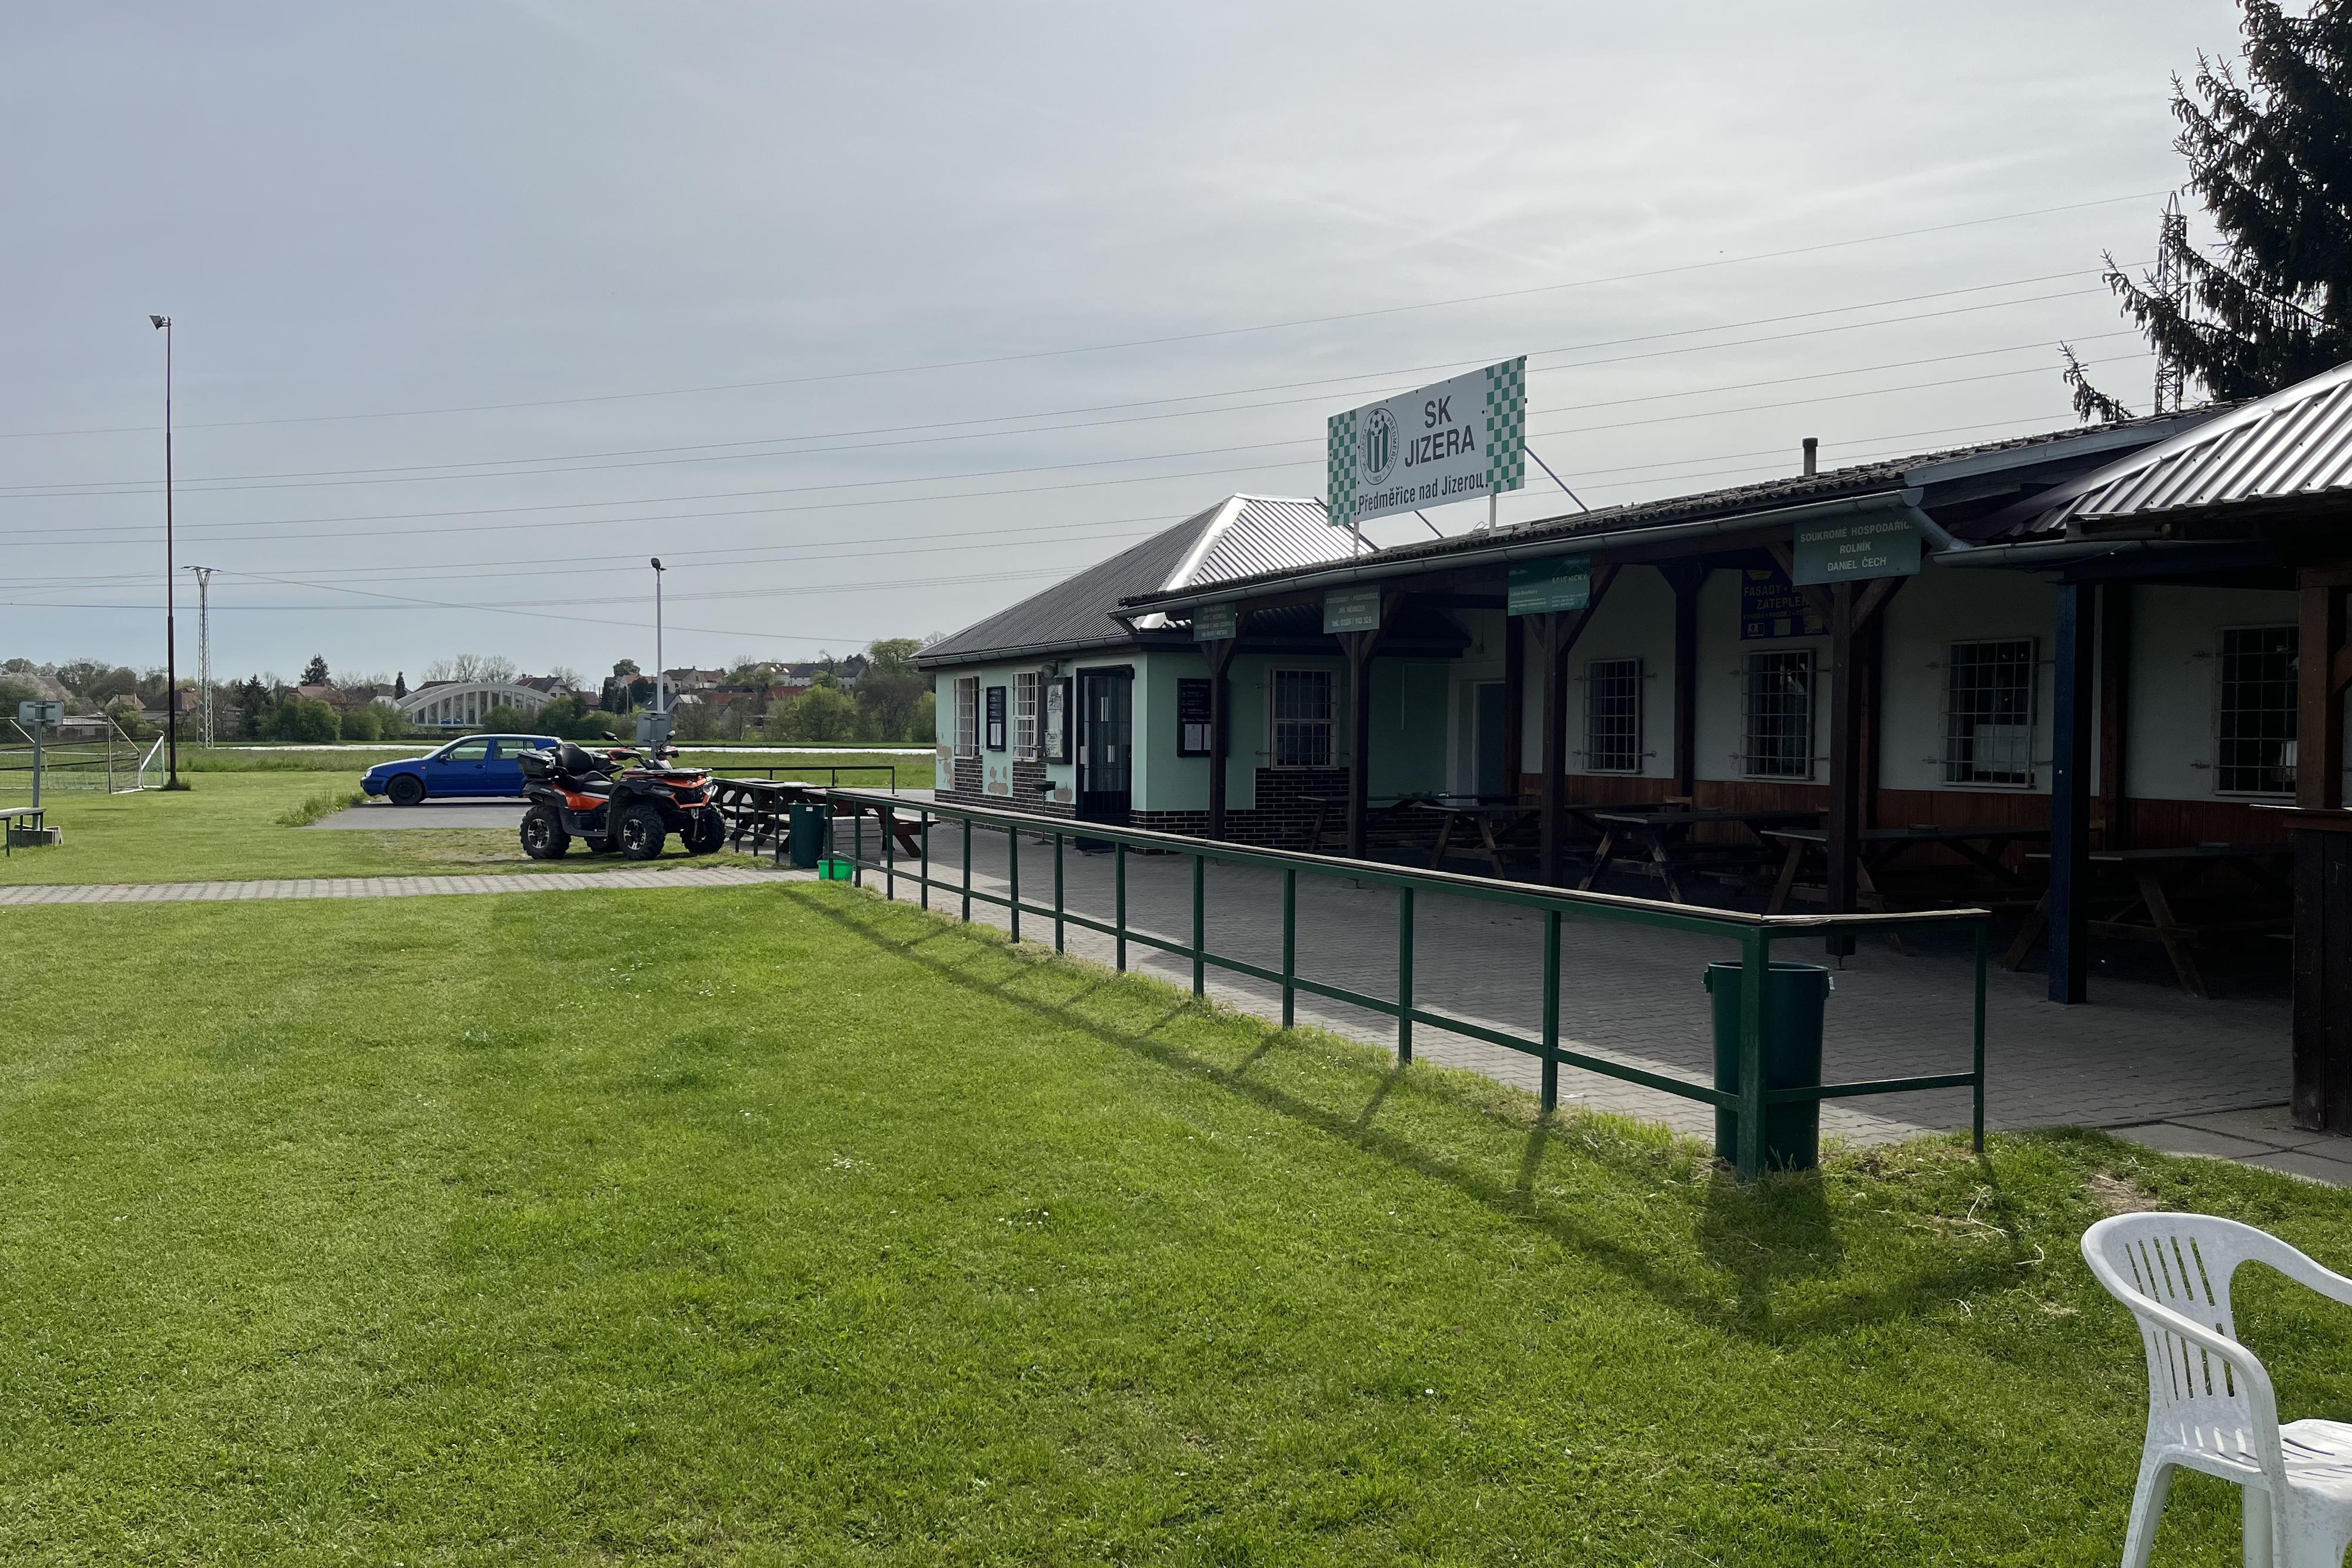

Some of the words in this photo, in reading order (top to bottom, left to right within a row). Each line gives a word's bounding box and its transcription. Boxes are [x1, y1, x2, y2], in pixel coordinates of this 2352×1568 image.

[1424, 395, 1452, 429] SK
[1404, 424, 1475, 467] JIZERA
[1359, 486, 1415, 513] Předměřice
[1419, 477, 1438, 499] nad
[1442, 472, 1482, 496] Jizerou
[1851, 519, 1912, 536] HOSPODAŘÍC
[1839, 541, 1872, 554] ROLNÍK
[1828, 560, 1858, 571] DANIEL
[1862, 556, 1886, 568] ČECH
